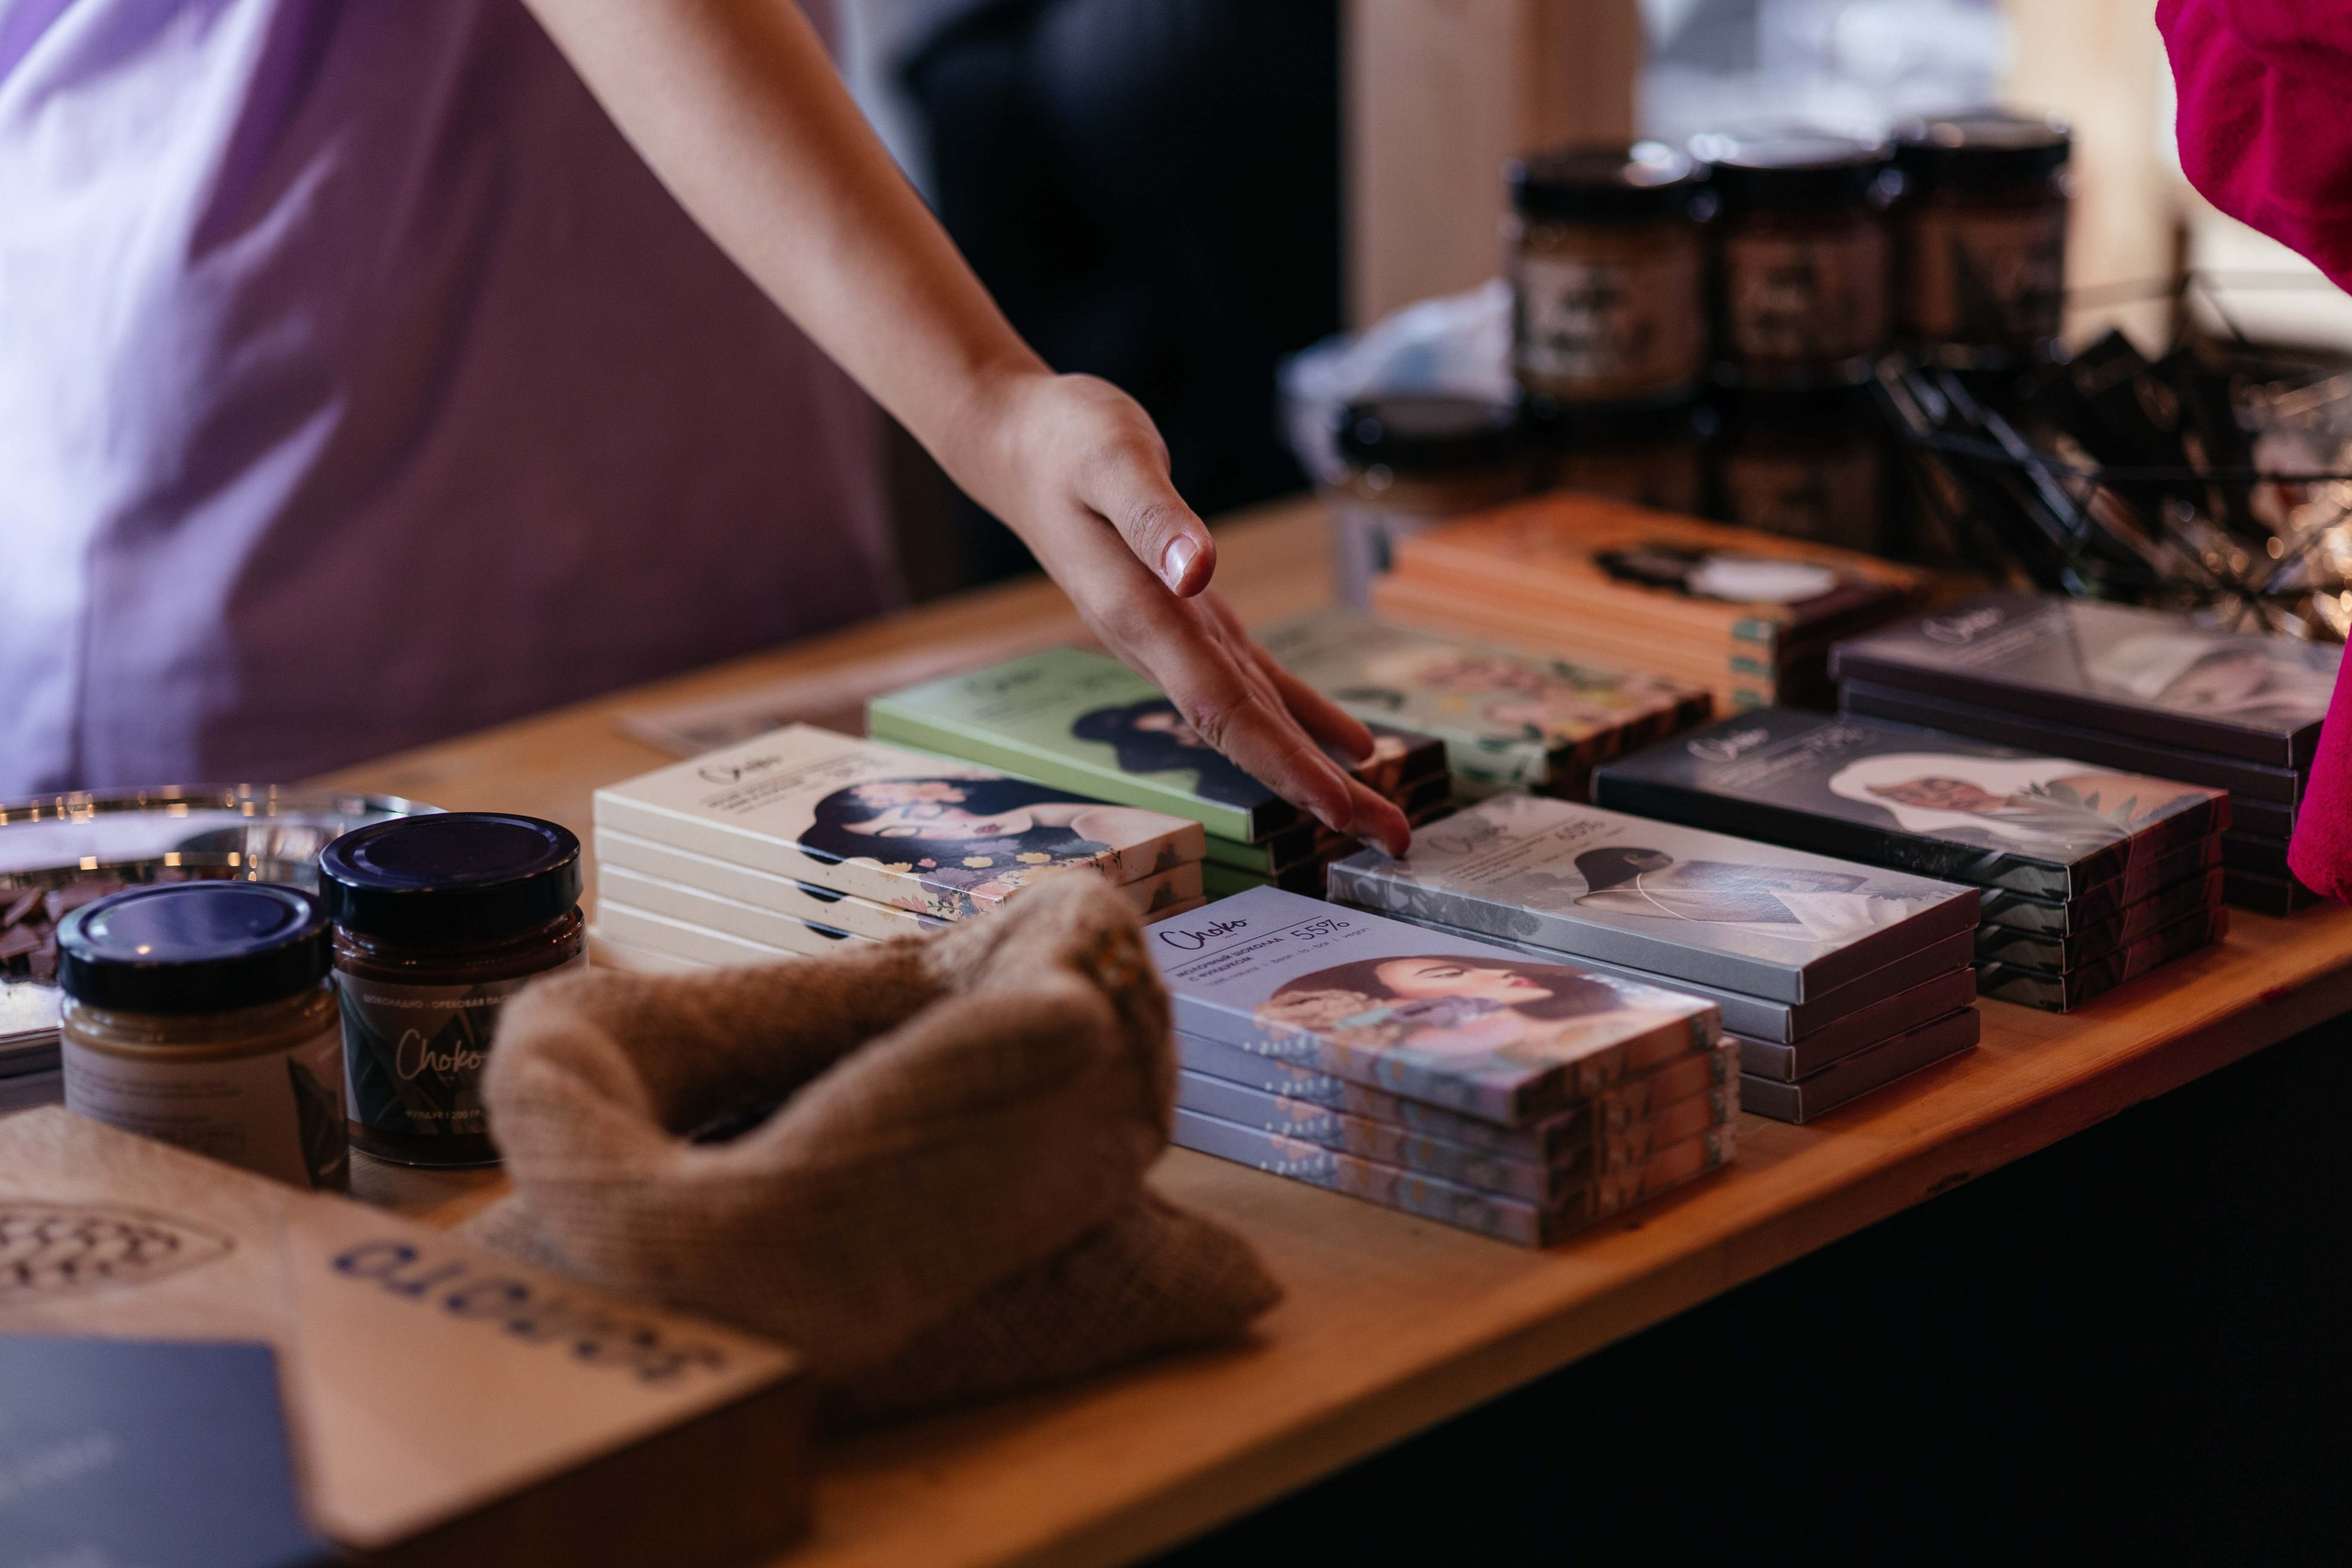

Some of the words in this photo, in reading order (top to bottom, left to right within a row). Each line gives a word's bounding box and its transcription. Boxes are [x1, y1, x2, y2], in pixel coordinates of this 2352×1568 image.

[1159, 919, 1248, 951] Choko
[1175, 953, 1234, 978] МОЛОЧНЫЙ
[1231, 936, 1285, 957] ШОКОЛАД
[1290, 919, 1351, 941] 55%
[431, 997, 484, 1010] ОРЕХОВАЯ
[396, 1028, 487, 1080] Choko
